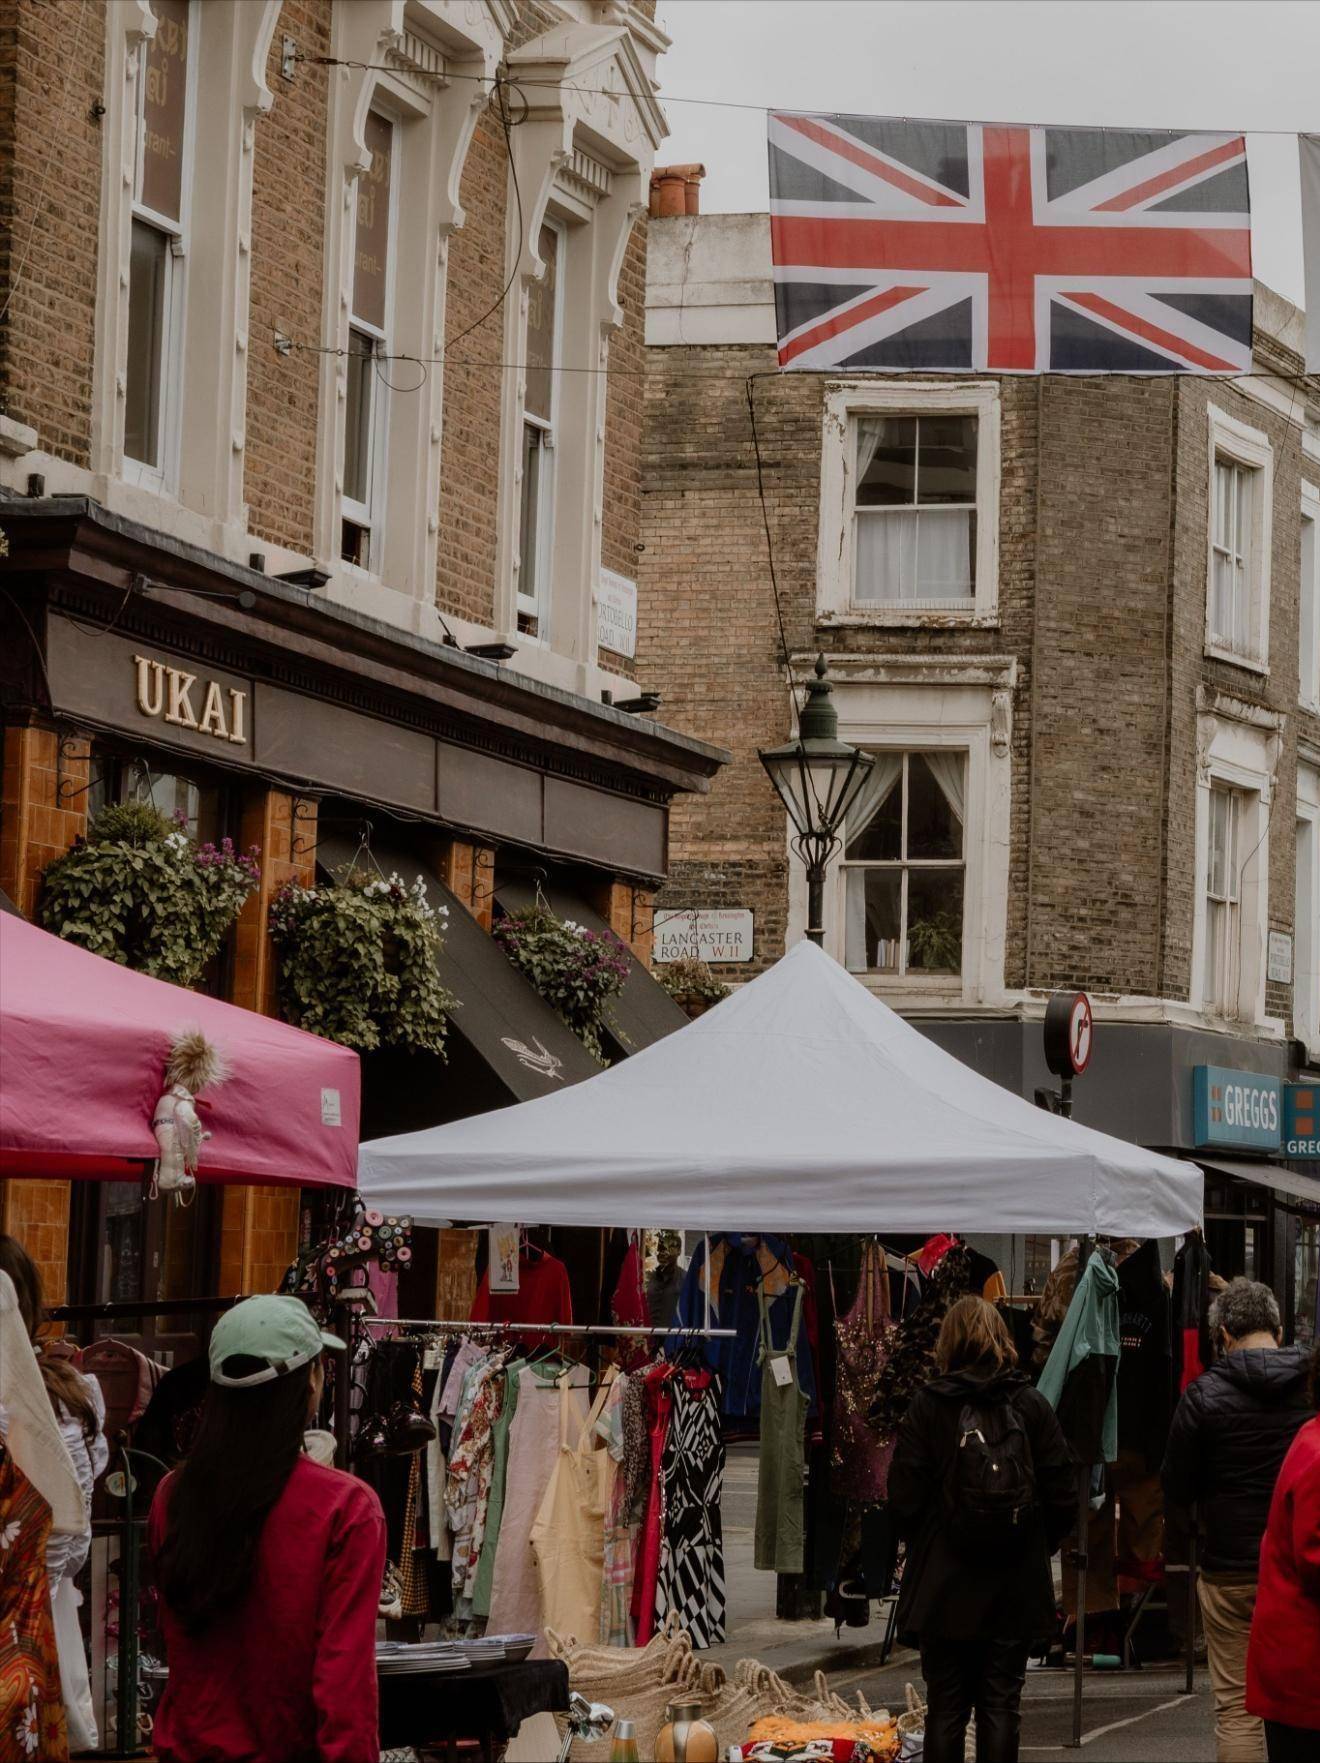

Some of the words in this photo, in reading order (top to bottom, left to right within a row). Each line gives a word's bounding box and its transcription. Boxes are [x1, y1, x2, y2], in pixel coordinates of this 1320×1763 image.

[134, 654, 247, 745] UKAI
[661, 945, 700, 959] ROAD
[662, 932, 743, 945] LANCASTER
[1224, 1084, 1278, 1132] GREGGS
